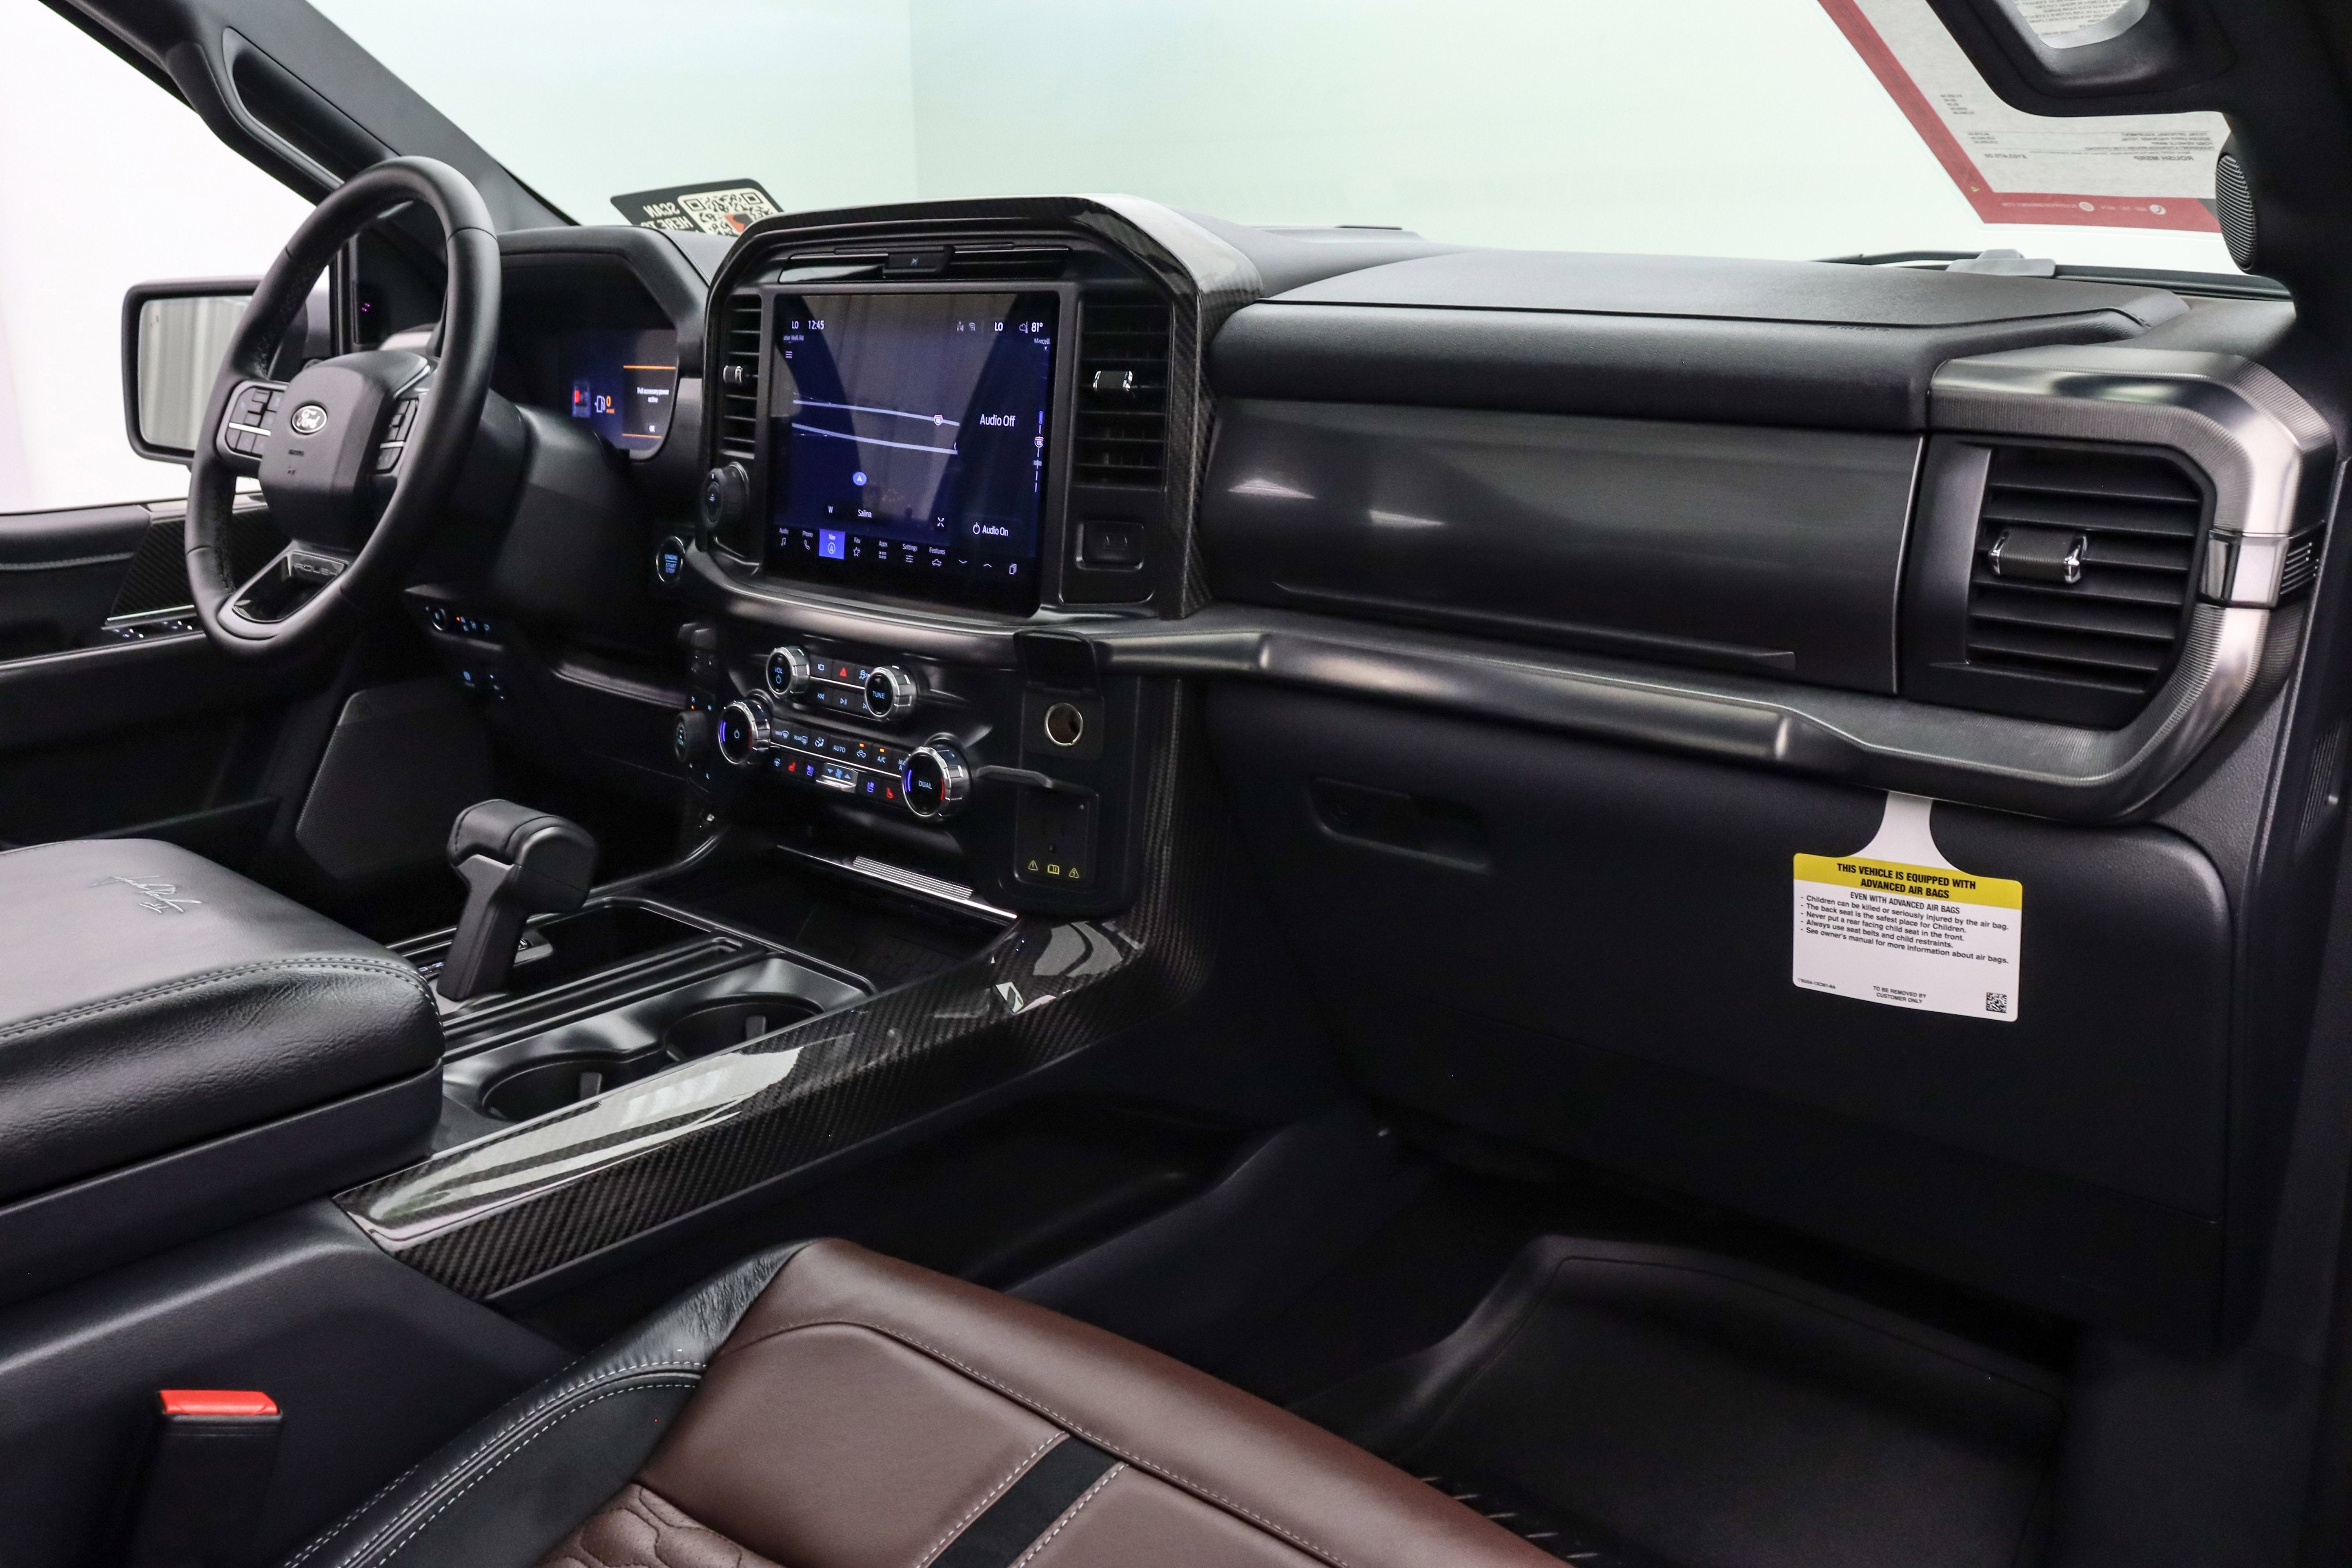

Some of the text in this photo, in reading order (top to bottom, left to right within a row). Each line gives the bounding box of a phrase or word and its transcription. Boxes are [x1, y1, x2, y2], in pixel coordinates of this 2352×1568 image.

[791, 321, 799, 329] LO
[808, 320, 825, 330] 12:45
[994, 322, 1004, 331] LO
[1031, 322, 1043, 332] 81°
[606, 396, 611, 407] 0
[980, 414, 1016, 427] Audio Off
[858, 509, 872, 518] Salina
[982, 525, 1009, 536] Audio On
[902, 543, 918, 552] Settings
[929, 547, 946, 555] Features
[873, 691, 885, 699] TUNE
[918, 780, 932, 789] DUAL
[1838, 863, 1976, 889] THIS VEHICLE IS EQUIPPED WITH
[1861, 878, 1949, 898] ADVANCED AIR BAGS
[1851, 892, 1960, 914] EVEN WITH ADVANCED AIR BAGS
[1806, 895, 1835, 905] Children
[1891, 909, 1924, 920] seriously
[1927, 914, 1952, 923] injured
[1955, 917, 1964, 925] by
[1993, 922, 2009, 931] bag.
[1821, 905, 1837, 913] back
[1876, 915, 1897, 924] safest
[1933, 923, 1967, 933] Children.
[1806, 919, 1831, 929] Always
[1863, 929, 1879, 937] belts
[1896, 934, 1913, 943] child
[1915, 936, 1953, 948] restraints.
[1862, 920, 1883, 931] facing
[1885, 924, 1902, 933] child
[1944, 933, 1964, 941] front.
[1820, 931, 1847, 940] owner's
[1849, 935, 1873, 944] manual
[1907, 944, 1950, 956] information
[1952, 951, 1973, 960] about
[1988, 955, 2009, 964] bags.
[1876, 992, 1907, 1002] CUSTOMER
[1890, 989, 1918, 997] REMOVED
